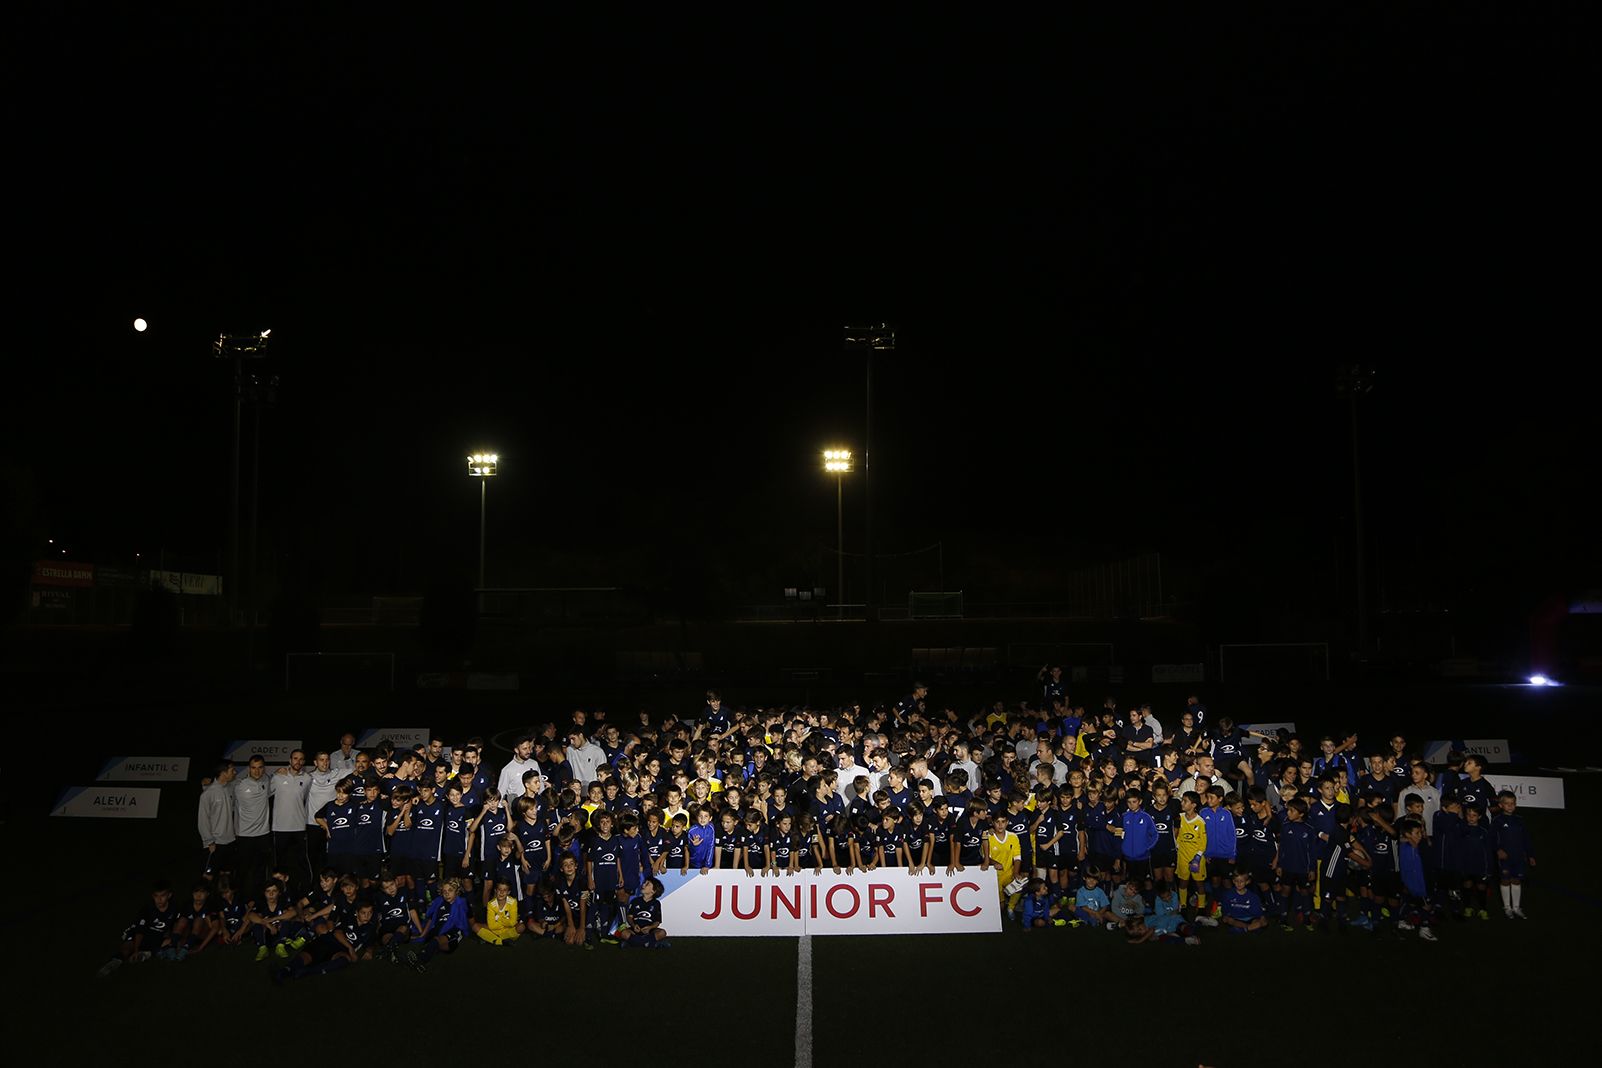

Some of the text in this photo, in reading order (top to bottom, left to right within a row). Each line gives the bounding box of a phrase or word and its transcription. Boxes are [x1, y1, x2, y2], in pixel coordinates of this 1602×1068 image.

[1197, 711, 1204, 724] 9
[1494, 746, 1501, 754] D
[125, 763, 178, 772] INFANTIL C
[1528, 785, 1537, 795] B
[93, 793, 137, 806] ALEVÍ A
[700, 881, 983, 920] JUNIOR FC
